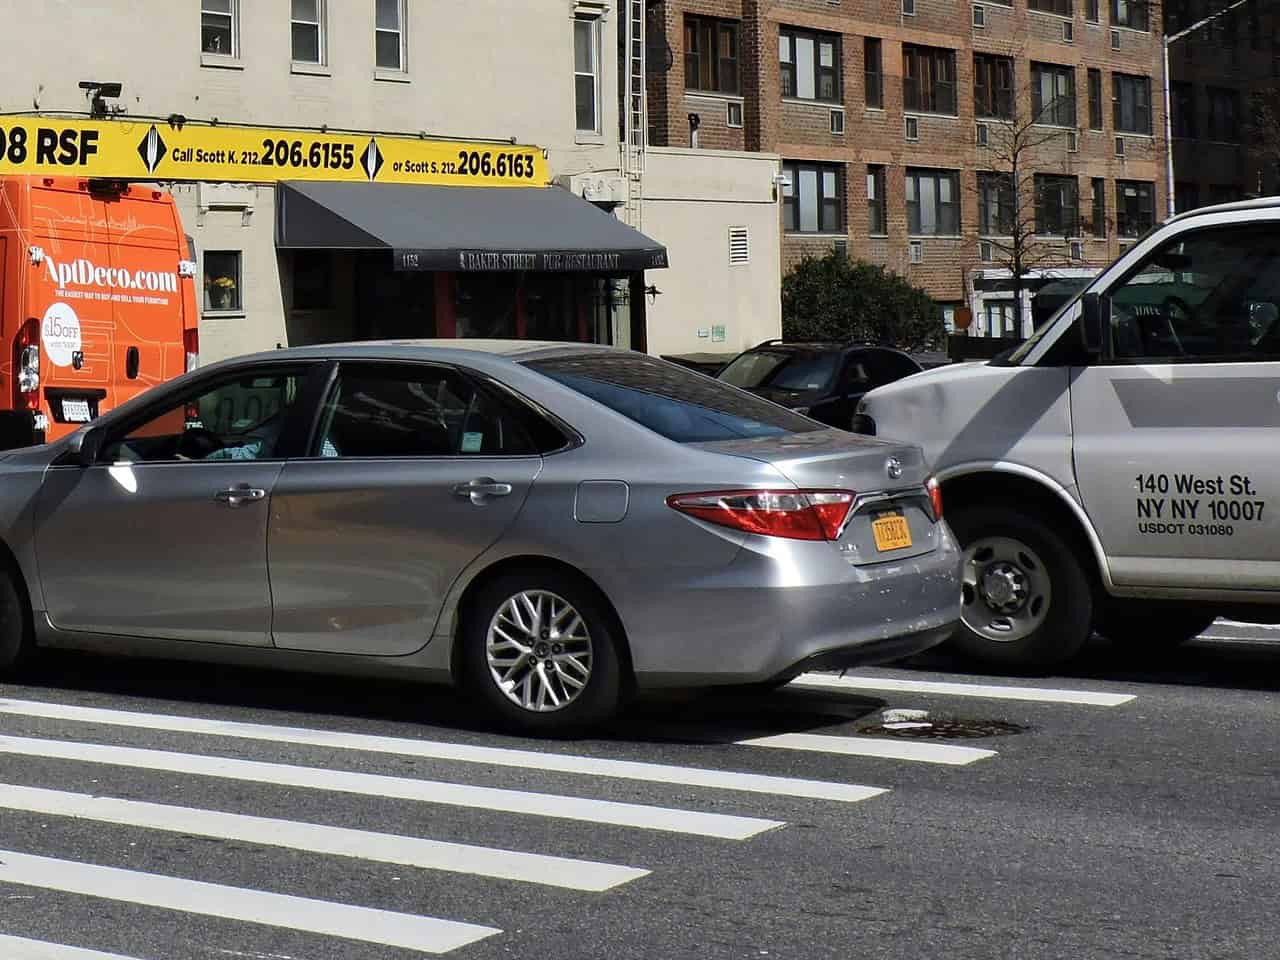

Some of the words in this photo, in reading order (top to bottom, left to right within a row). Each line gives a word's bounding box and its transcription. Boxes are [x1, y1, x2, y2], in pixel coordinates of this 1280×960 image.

[36, 128, 100, 166] RSF
[172, 148, 193, 162] Call
[196, 149, 225, 164] Scott
[229, 150, 238, 164] K.
[392, 161, 403, 172] or
[405, 160, 429, 173] Scott
[432, 162, 439, 173] S.
[402, 253, 419, 268] 1152
[469, 253, 500, 271] BAKER
[502, 253, 537, 271] STREET
[43, 255, 178, 292] AptDeco.com
[63, 326, 78, 339] OFF
[1136, 474, 1169, 493] 140
[1174, 474, 1224, 495] West
[1230, 475, 1256, 496] St.
[1137, 498, 1164, 518] NY
[1172, 499, 1199, 519] NY
[1208, 501, 1265, 521] 10007
[1139, 523, 1185, 535] USDOT
